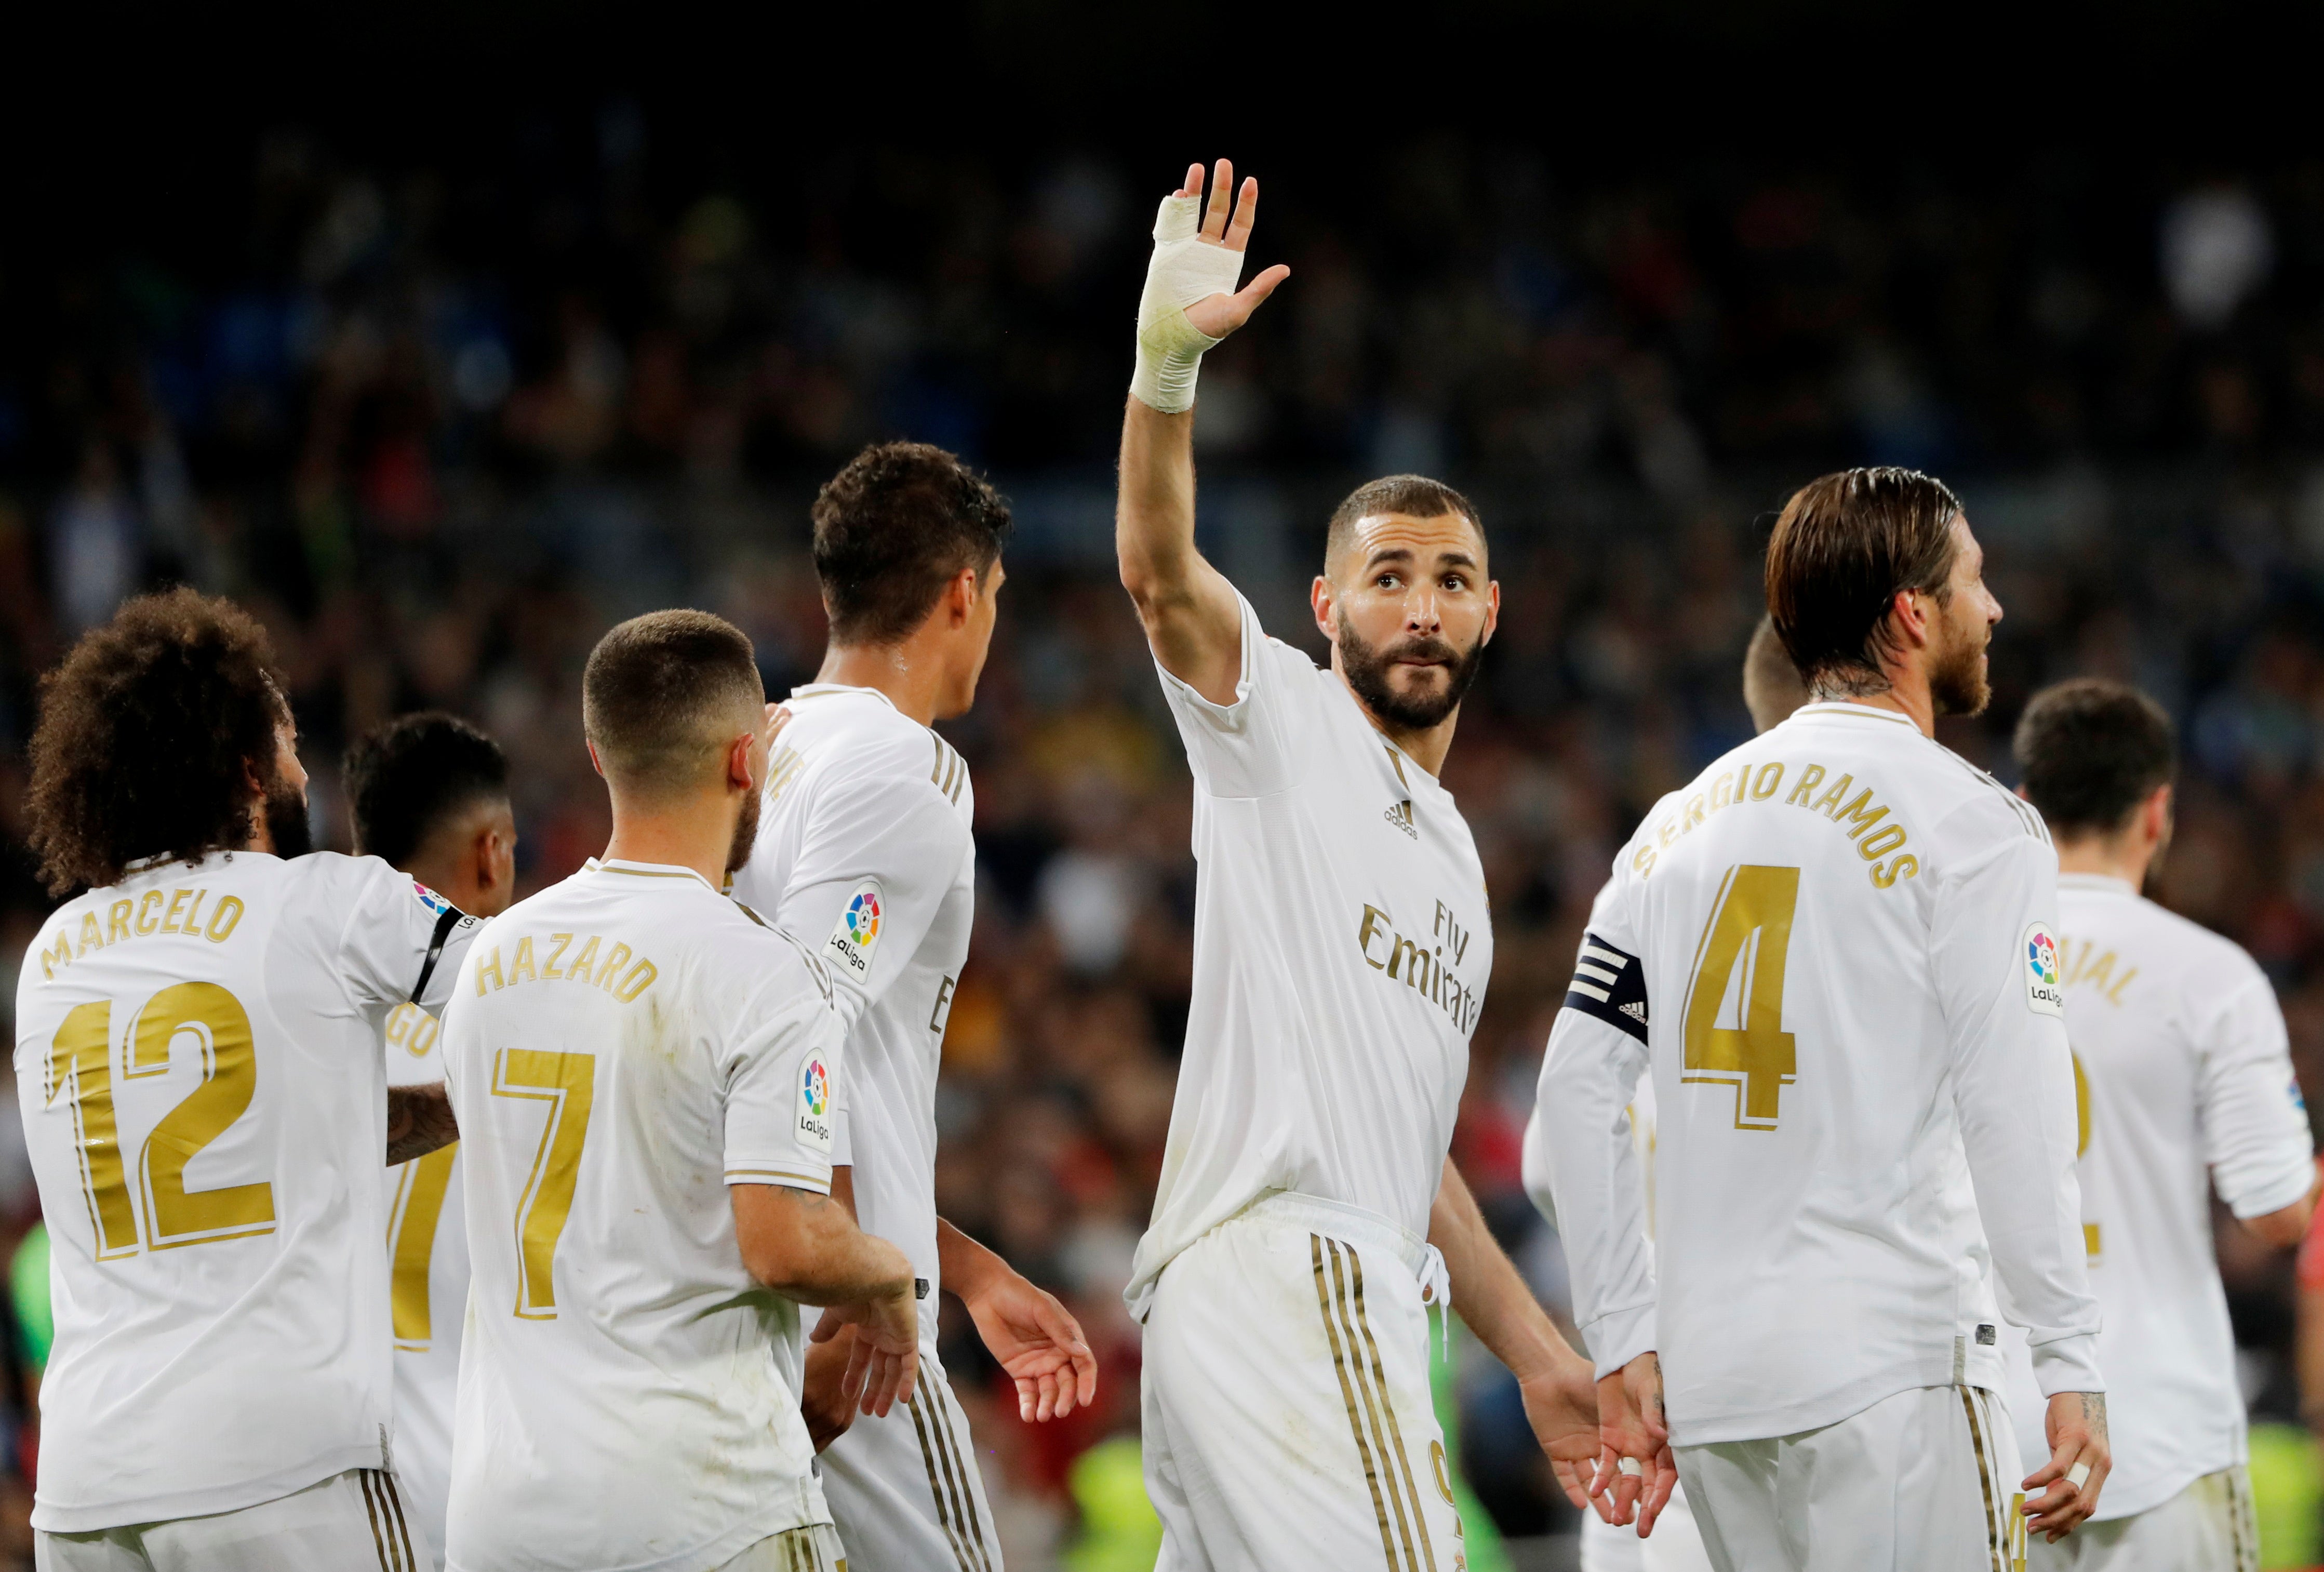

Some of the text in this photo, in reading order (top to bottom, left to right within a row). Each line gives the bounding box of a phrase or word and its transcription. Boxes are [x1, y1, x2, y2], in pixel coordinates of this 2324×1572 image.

[1384, 810, 1418, 840] adidas
[1633, 762, 1918, 889] SERGIO RAMOS
[40, 888, 245, 984] MARCELO
[830, 934, 866, 972] LaLiga
[1434, 898, 1469, 967] Fly
[475, 933, 658, 1004] HAZARD
[1680, 864, 1800, 1131] 4
[930, 974, 955, 1034] E
[1619, 1004, 1647, 1024] adidas
[44, 981, 275, 1262] 12
[799, 1115, 829, 1141] LaLiga
[490, 1047, 595, 1321] 7
